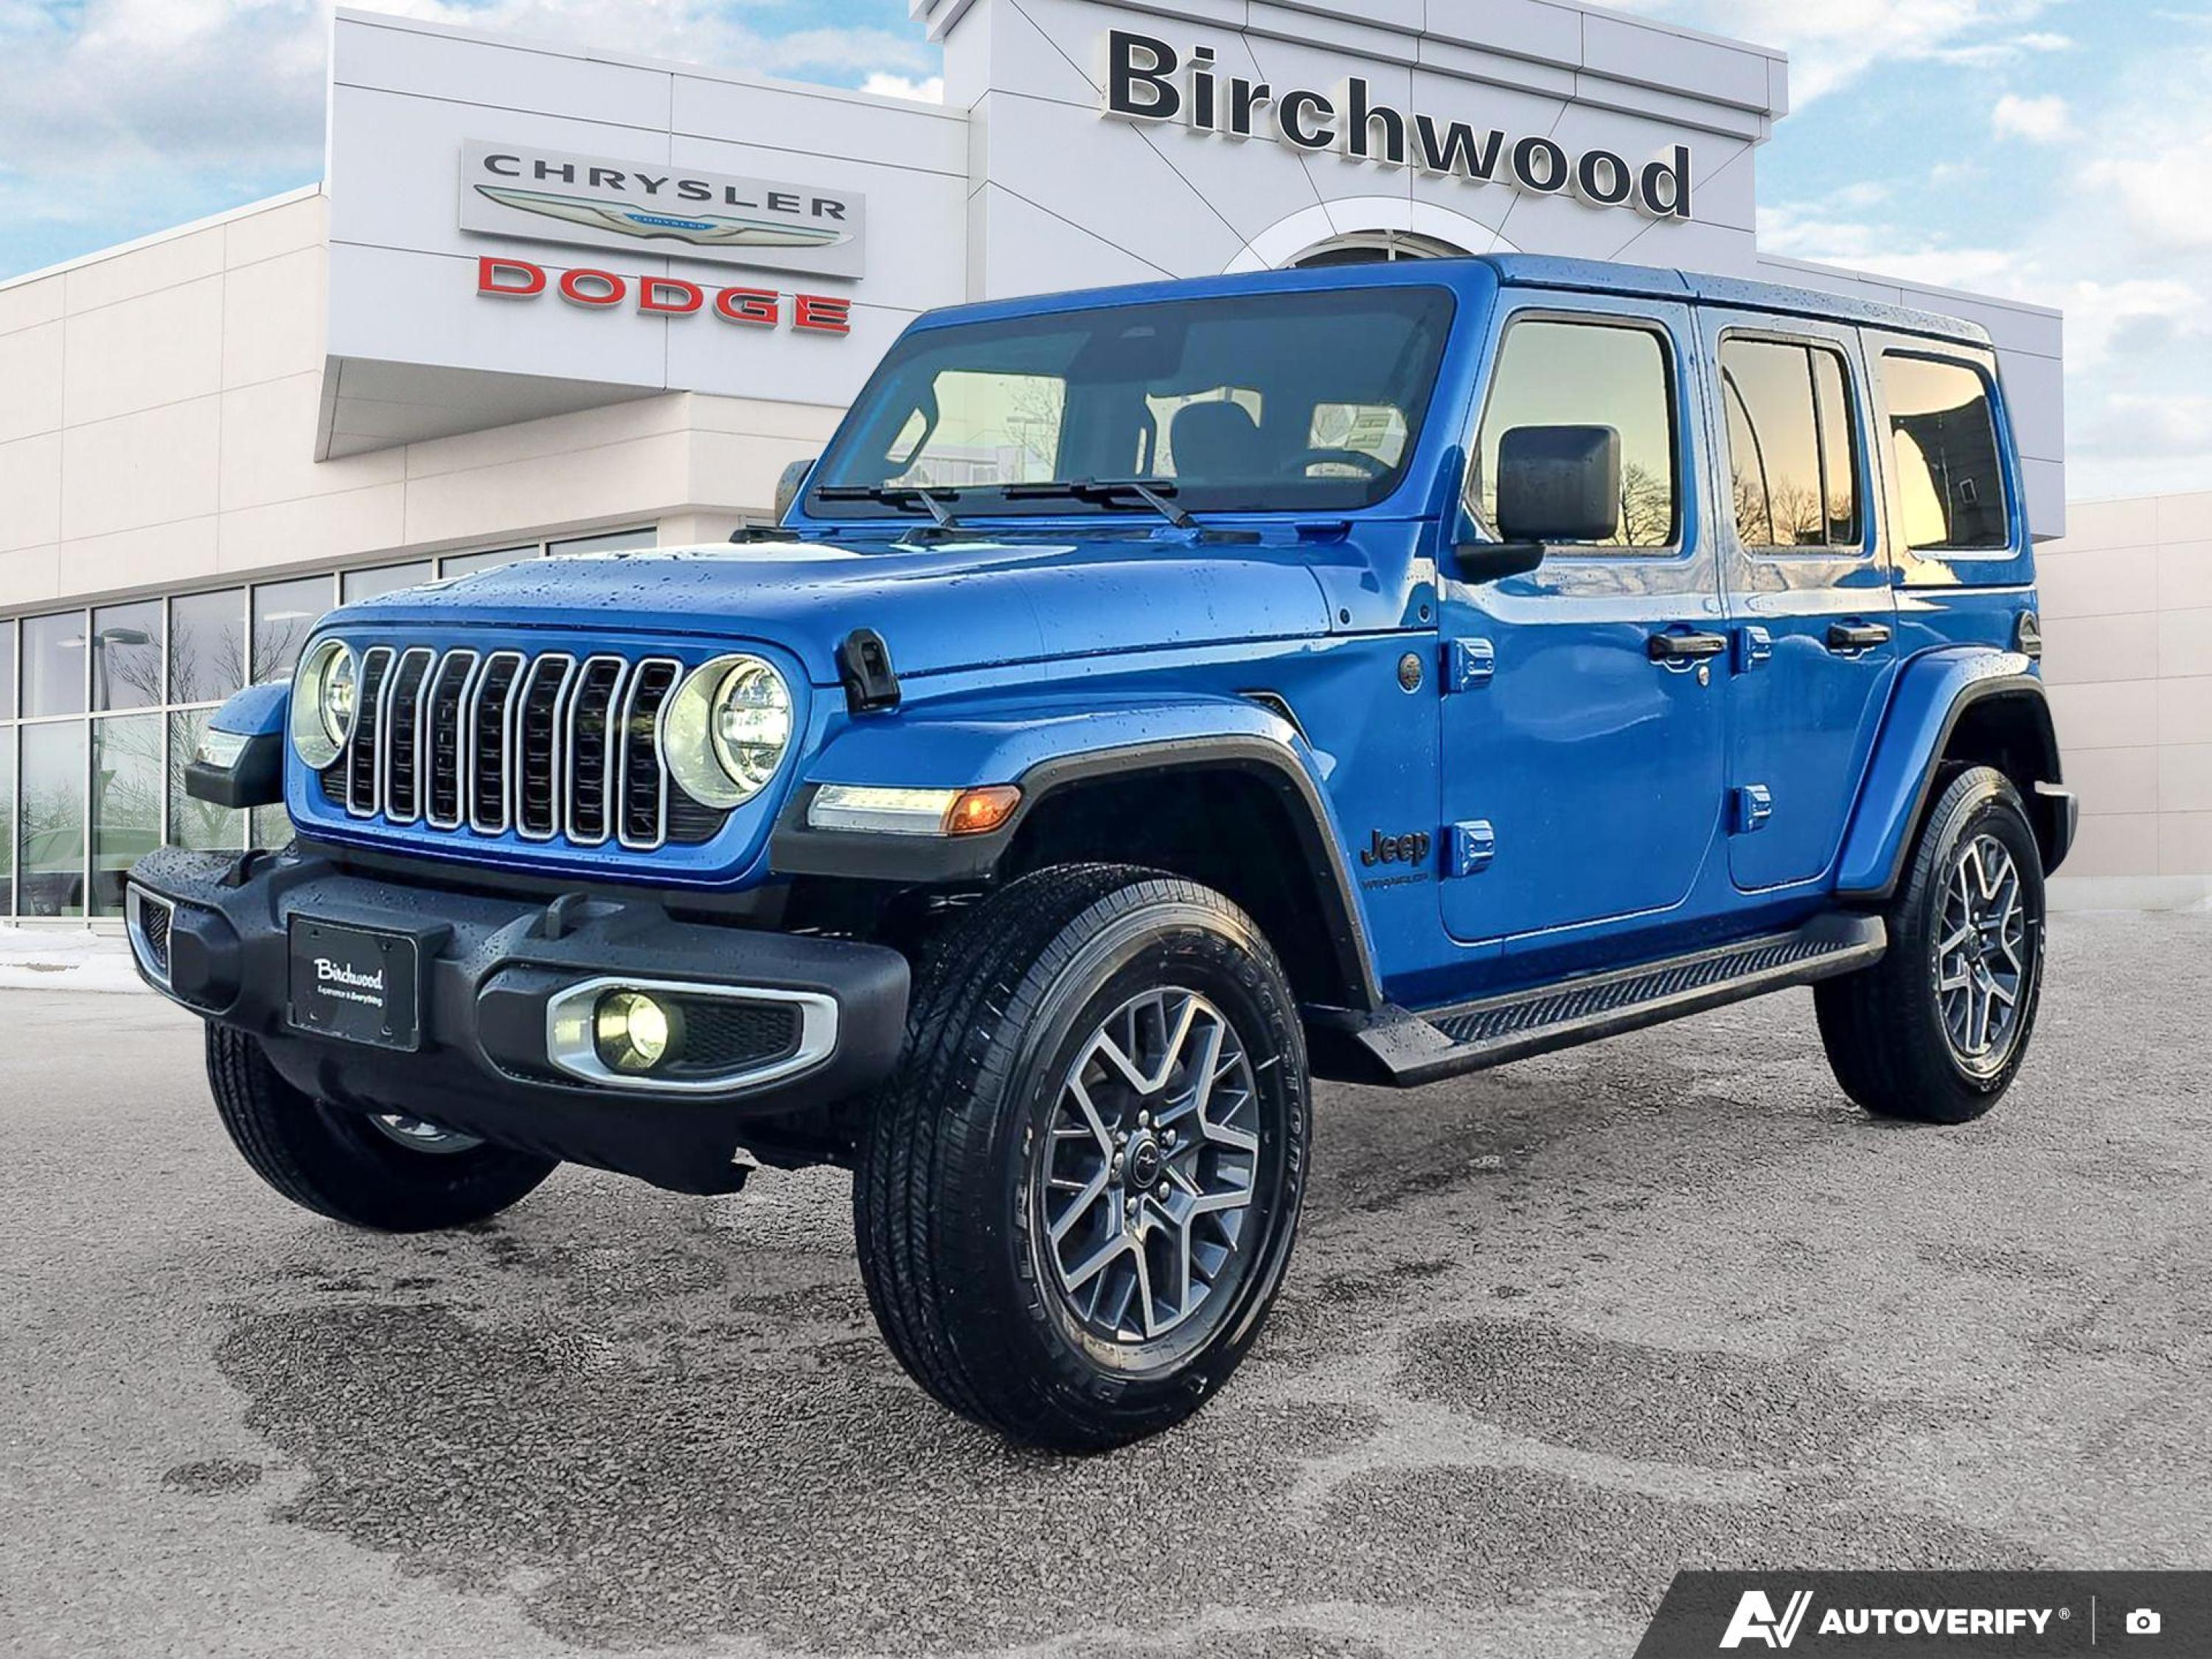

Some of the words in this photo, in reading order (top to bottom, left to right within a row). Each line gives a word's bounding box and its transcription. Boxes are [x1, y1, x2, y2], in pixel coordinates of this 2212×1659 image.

[1102, 27, 1693, 223] Birchwood
[484, 154, 846, 220] CHRYSLER
[476, 255, 852, 336] DODGE
[1360, 829, 1430, 868] Jeep
[314, 958, 383, 990] Birchwood
